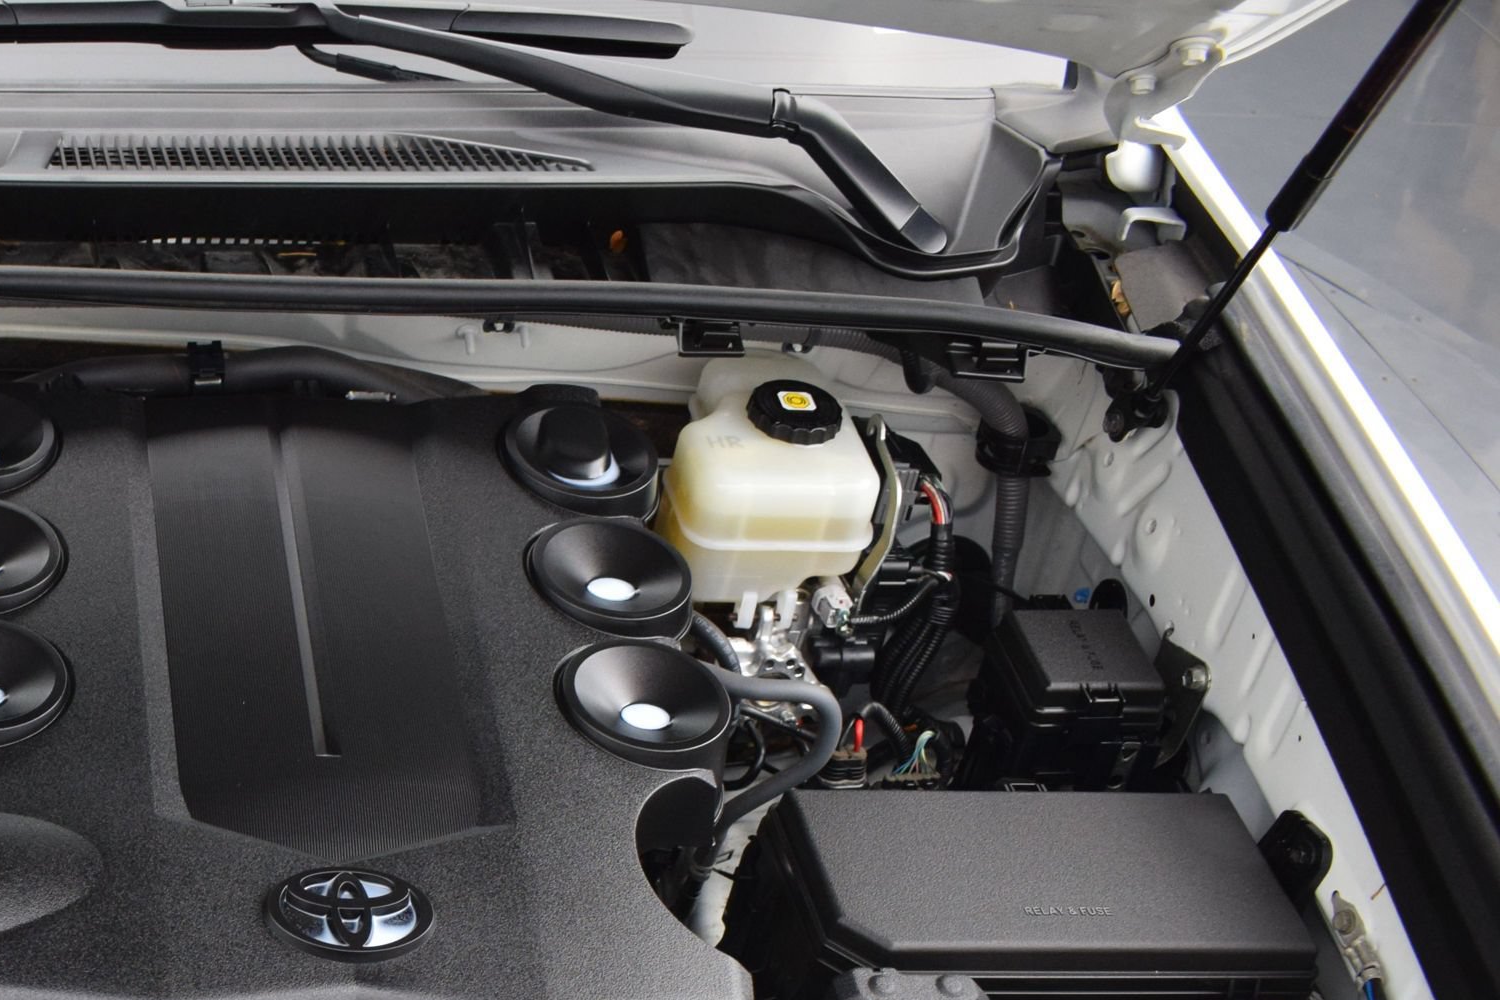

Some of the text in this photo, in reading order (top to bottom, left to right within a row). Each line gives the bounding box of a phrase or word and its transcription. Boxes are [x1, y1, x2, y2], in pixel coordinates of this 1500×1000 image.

[1023, 905, 1114, 917] RELAY & FUSE
